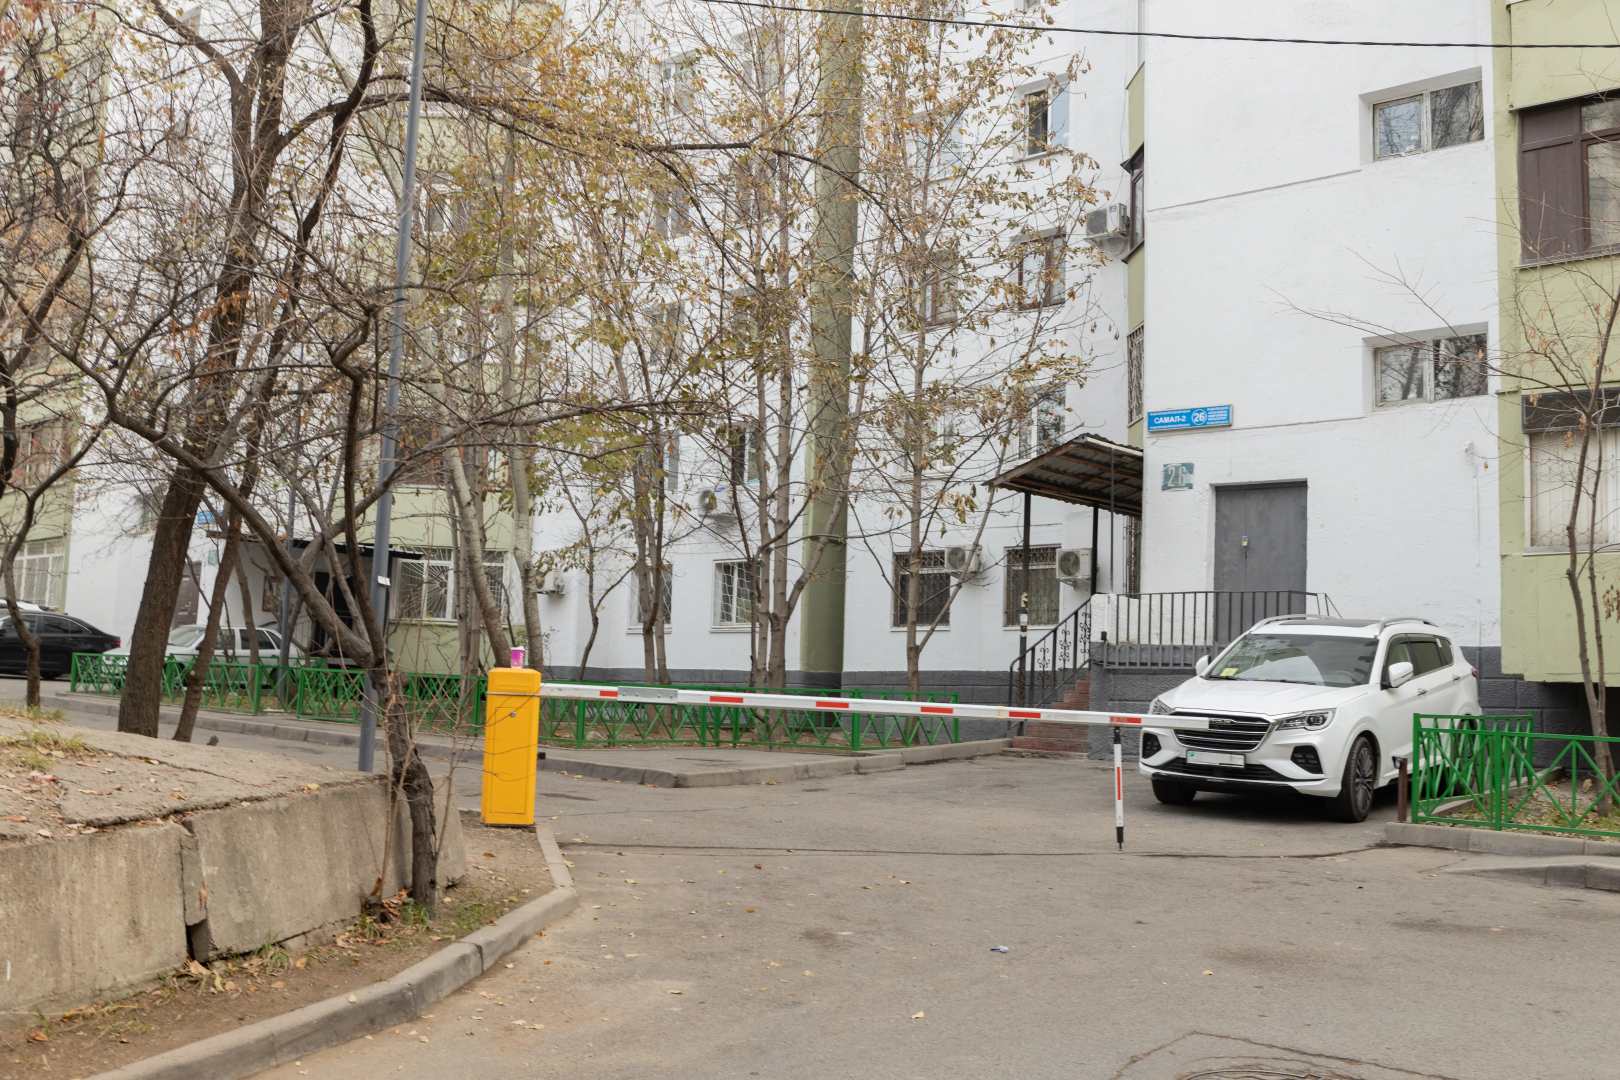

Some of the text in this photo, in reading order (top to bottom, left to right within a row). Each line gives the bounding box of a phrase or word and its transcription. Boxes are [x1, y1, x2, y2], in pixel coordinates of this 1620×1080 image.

[1154, 415, 1186, 424] САМАЛ-2
[1194, 412, 1205, 422] 26
[1168, 466, 1186, 487] 26
